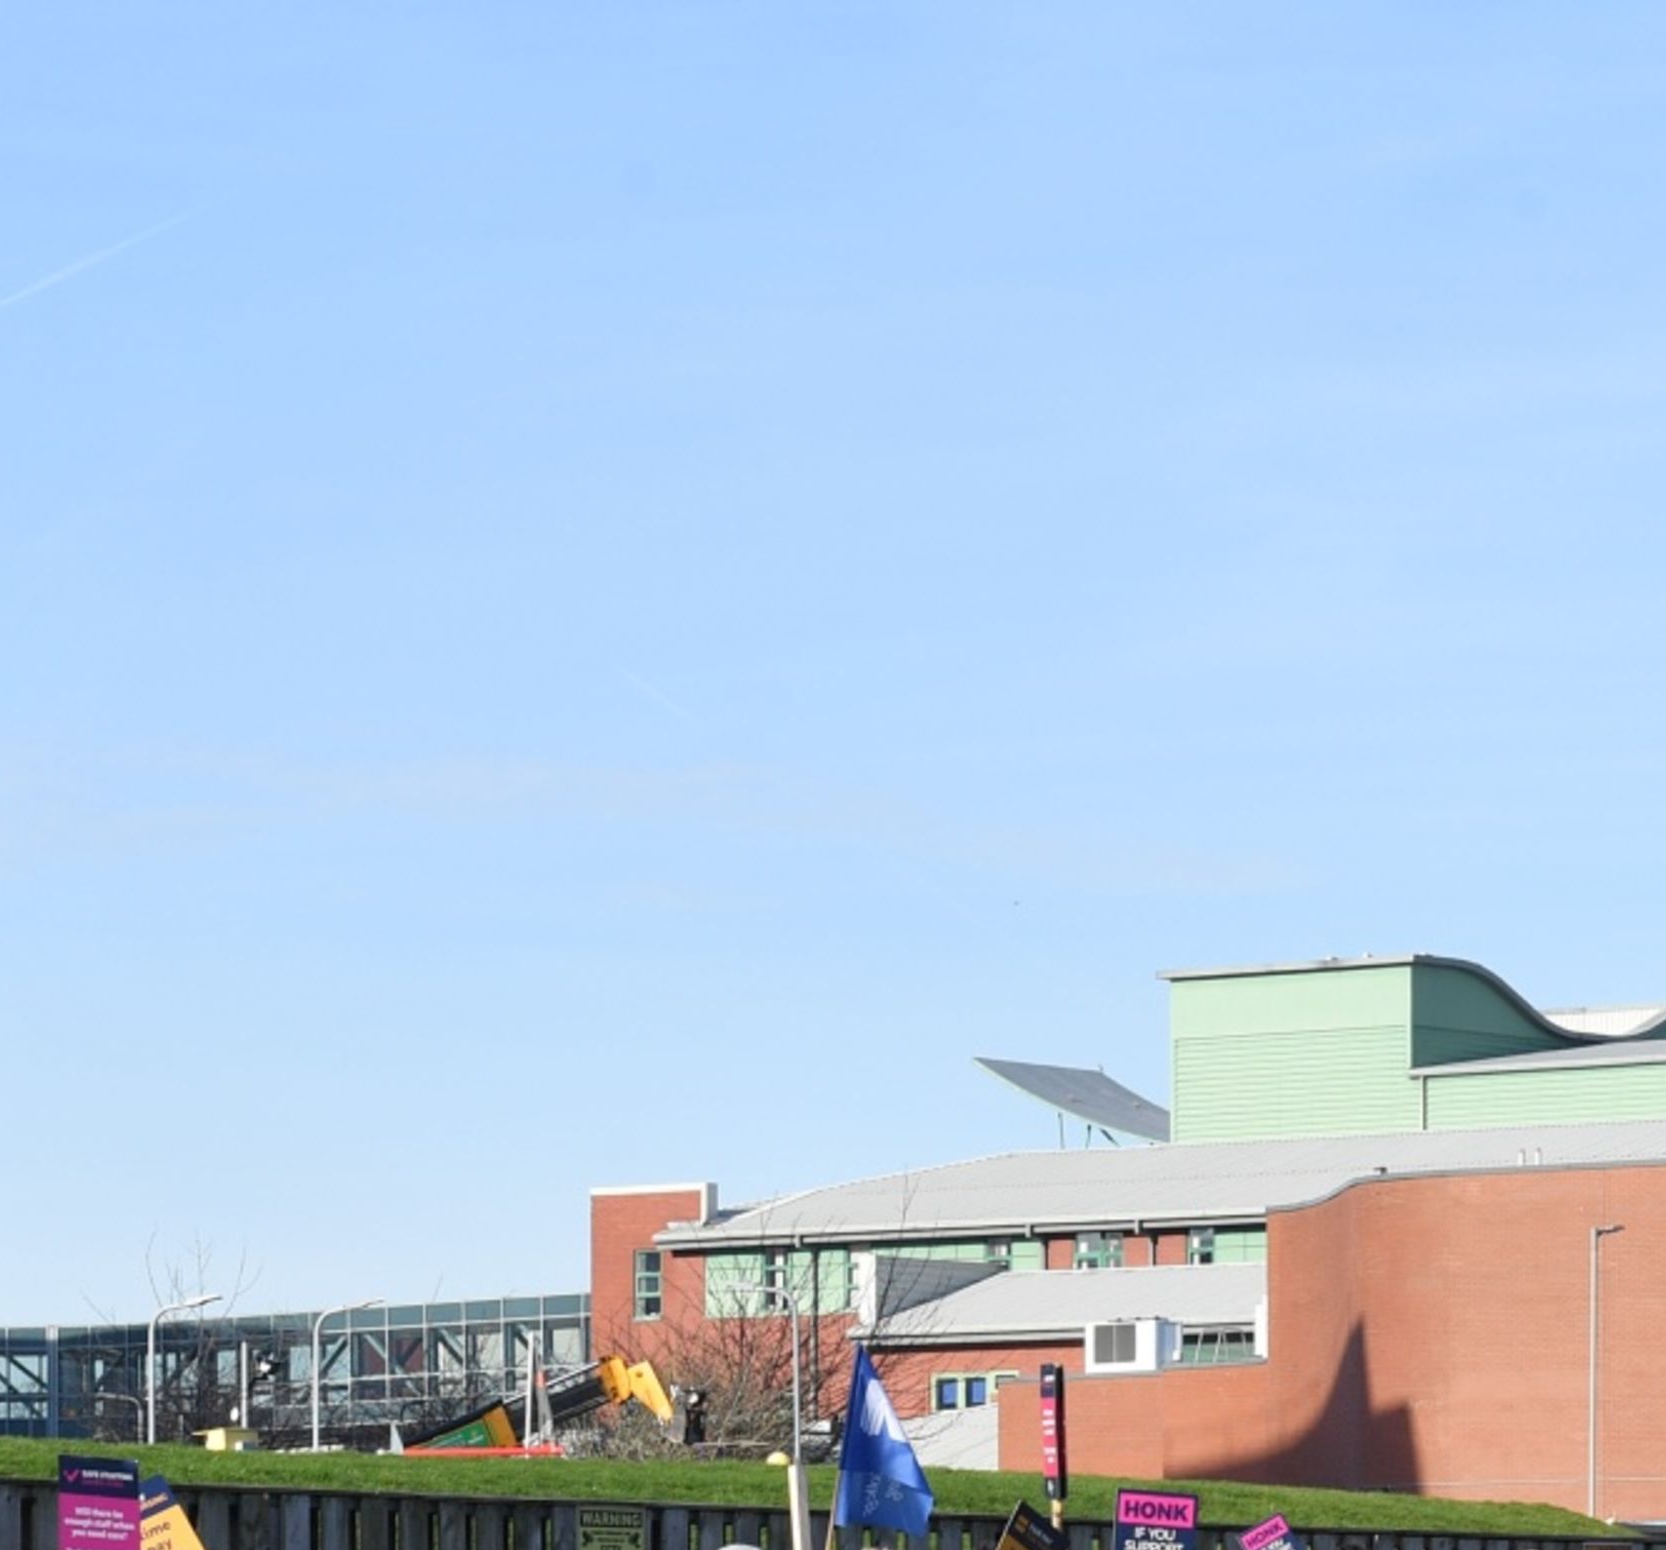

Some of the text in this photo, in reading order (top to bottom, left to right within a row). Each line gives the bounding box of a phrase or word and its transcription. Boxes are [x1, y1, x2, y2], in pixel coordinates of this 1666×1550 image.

[1124, 1500, 1189, 1522] HONK
[1135, 1526, 1176, 1541] IF YOU
